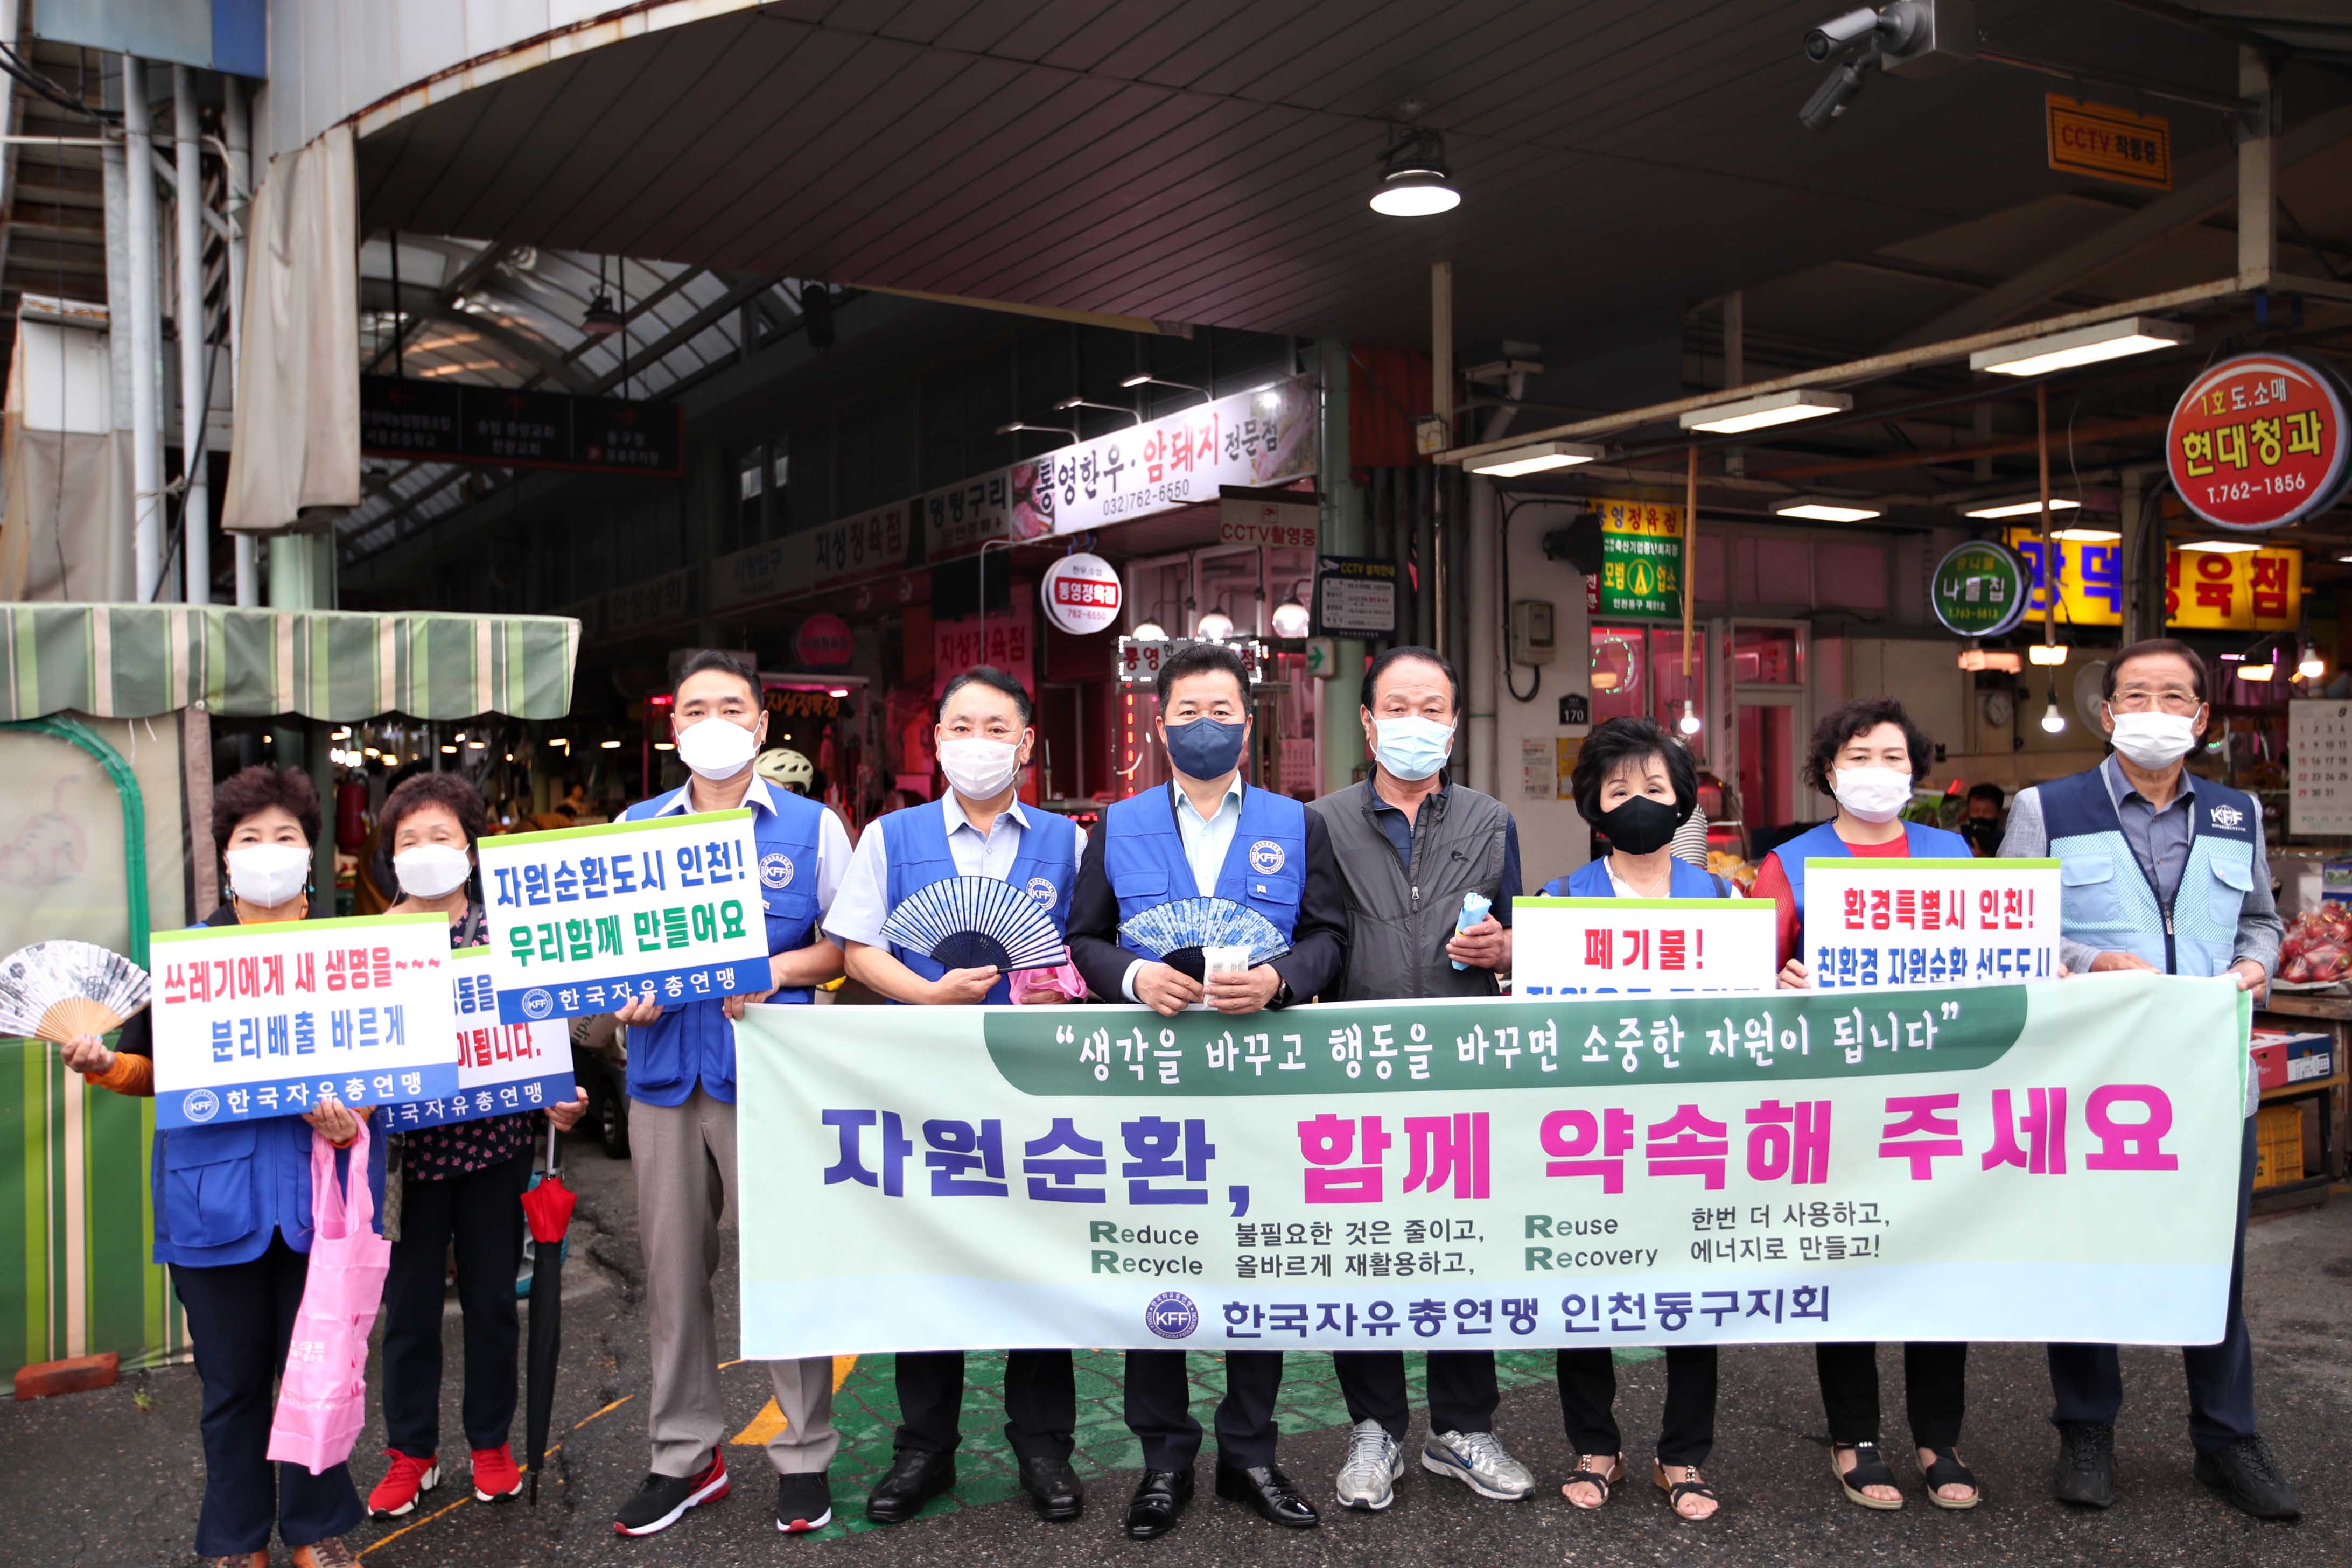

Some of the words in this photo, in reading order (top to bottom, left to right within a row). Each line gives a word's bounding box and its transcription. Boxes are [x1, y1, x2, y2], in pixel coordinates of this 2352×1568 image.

[2061, 124, 2111, 153] CCTV
[2201, 391, 2227, 416] 1호
[1144, 412, 1219, 483] 암돼지
[1225, 417, 1278, 461] 전문점
[2182, 410, 2322, 477] 현대청과
[1103, 480, 1189, 516] 032)762-6550
[2207, 473, 2305, 503] T.762-1856
[817, 510, 901, 570] 지성정육점
[1059, 582, 1116, 605] 통영정육점
[1604, 562, 1625, 591] 모범
[1068, 609, 1106, 620] 762-6550
[941, 626, 1025, 668] 지성정육점
[1123, 647, 1159, 670] 통영
[1564, 709, 1584, 722] 170
[2210, 809, 2243, 825] KFF
[494, 850, 667, 908] 자원순환도시
[677, 839, 745, 887] 인천!
[766, 866, 786, 877] KFF
[1257, 852, 1277, 863] KFF
[1033, 890, 1051, 899] KFF
[1843, 887, 1965, 930] 환경특별시
[1979, 888, 2033, 929] 인천!
[509, 914, 624, 967] 우리함께
[634, 899, 746, 953] 만들어요
[1585, 929, 1702, 970] 폐기물!
[165, 954, 285, 1004] 쓰레기에게
[295, 951, 316, 994] 새
[1818, 946, 1878, 988] 친환경
[1887, 946, 1967, 984] 자원순환
[453, 974, 495, 1015] 동을
[529, 999, 547, 1009] KFF
[559, 967, 736, 1011] 한국자유총연맹
[212, 1011, 316, 1063] 분리배출
[331, 1004, 405, 1051] 바르게
[1206, 1030, 1306, 1076] 바꾸고
[1328, 1023, 1433, 1079] 행동을
[1457, 1020, 1558, 1072] 바꾸면
[1582, 1017, 1684, 1070] 소중한
[1706, 1009, 1810, 1067] 자원이
[190, 1100, 212, 1111] KFF
[227, 1070, 422, 1114] 한국자유총연맹
[822, 1109, 1249, 1217] 자원순환,
[1297, 1112, 1489, 1204] 함께
[1539, 1098, 1831, 1194] 약속해
[1878, 1084, 2180, 1181] 주세요
[1089, 1220, 1199, 1245] Reduce
[1235, 1220, 1333, 1246] 불필요한
[1345, 1220, 1392, 1245] 것은
[1403, 1218, 1484, 1243] 줄이고,
[1525, 1214, 1618, 1238] Reuse
[1691, 1206, 1736, 1231] 한번
[1750, 1204, 1770, 1228] 더
[1783, 1201, 1890, 1227] 사용하고,
[1091, 1249, 1203, 1276] Recycle
[1235, 1253, 1332, 1278] 올바르게
[1344, 1251, 1474, 1277] 재활용하고,
[1525, 1245, 1657, 1271] Recovery
[1691, 1237, 1787, 1263] 에너지로
[1800, 1234, 1880, 1260] 만들고!
[1156, 1312, 1188, 1325] KFF
[1223, 1298, 1538, 1339] 한국자유총연맹
[1562, 1285, 1829, 1333] 인천동구지회
